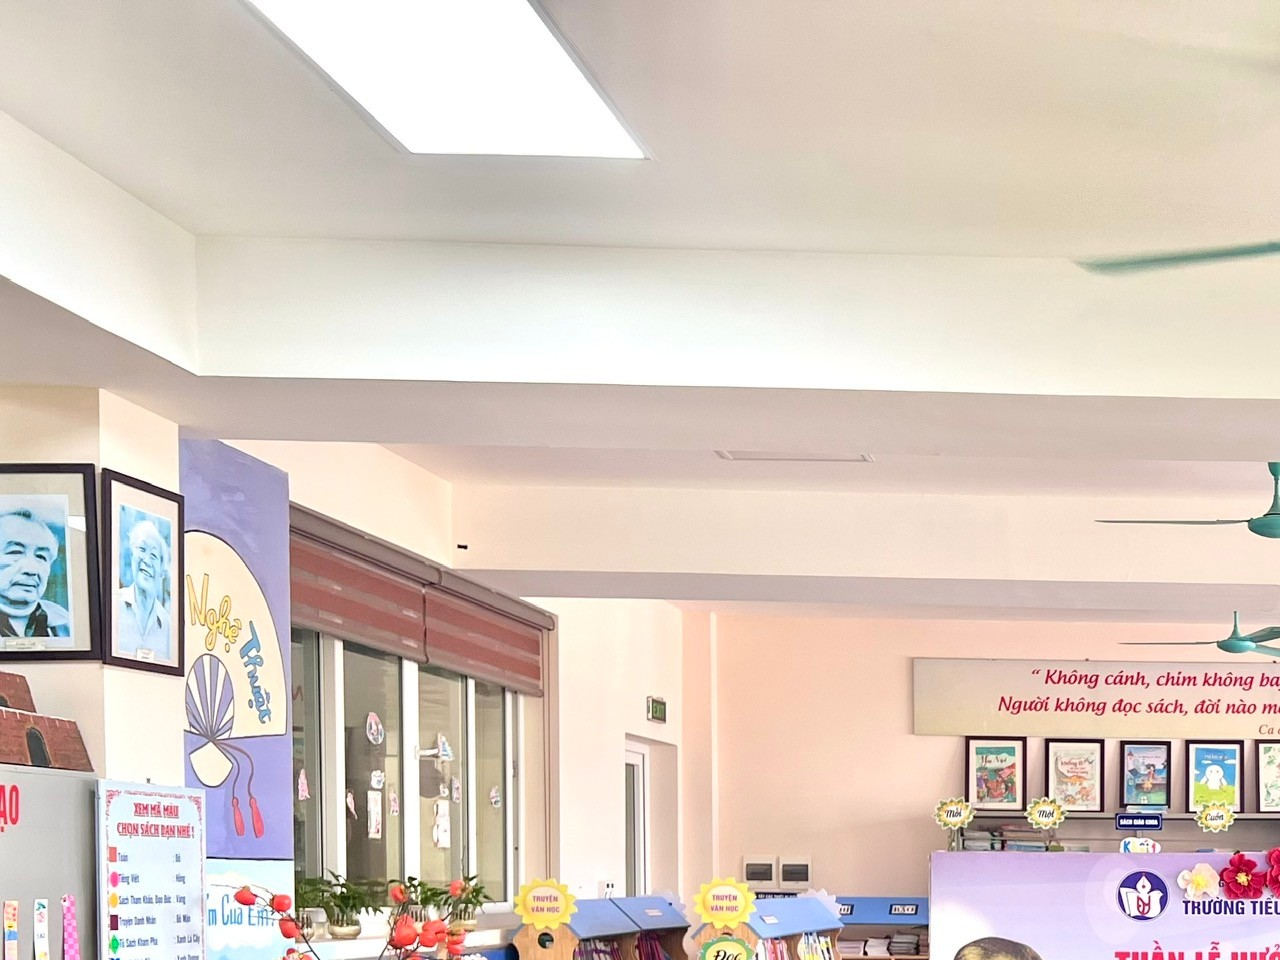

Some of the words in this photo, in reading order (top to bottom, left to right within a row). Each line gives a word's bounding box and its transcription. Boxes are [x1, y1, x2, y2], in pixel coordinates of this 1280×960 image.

[1045, 669, 1099, 689] Không
[1105, 671, 1151, 689] cánh,
[1156, 672, 1198, 687] chim
[1202, 672, 1255, 691] không
[998, 696, 1050, 715] Người
[1054, 696, 1107, 716] không
[1112, 698, 1142, 717] đọc
[1146, 699, 1188, 716] sách,
[1194, 698, 1221, 715] đời
[1225, 700, 1257, 715] nào
[1258, 724, 1275, 735] Ca
[134, 802, 149, 816] XEM
[117, 822, 139, 838] CHỌN
[141, 822, 159, 836] SÁCH
[533, 895, 558, 903] TRUYỆN
[712, 894, 738, 902] TRUYỆN
[1182, 899, 1245, 916] TRƯỜNG
